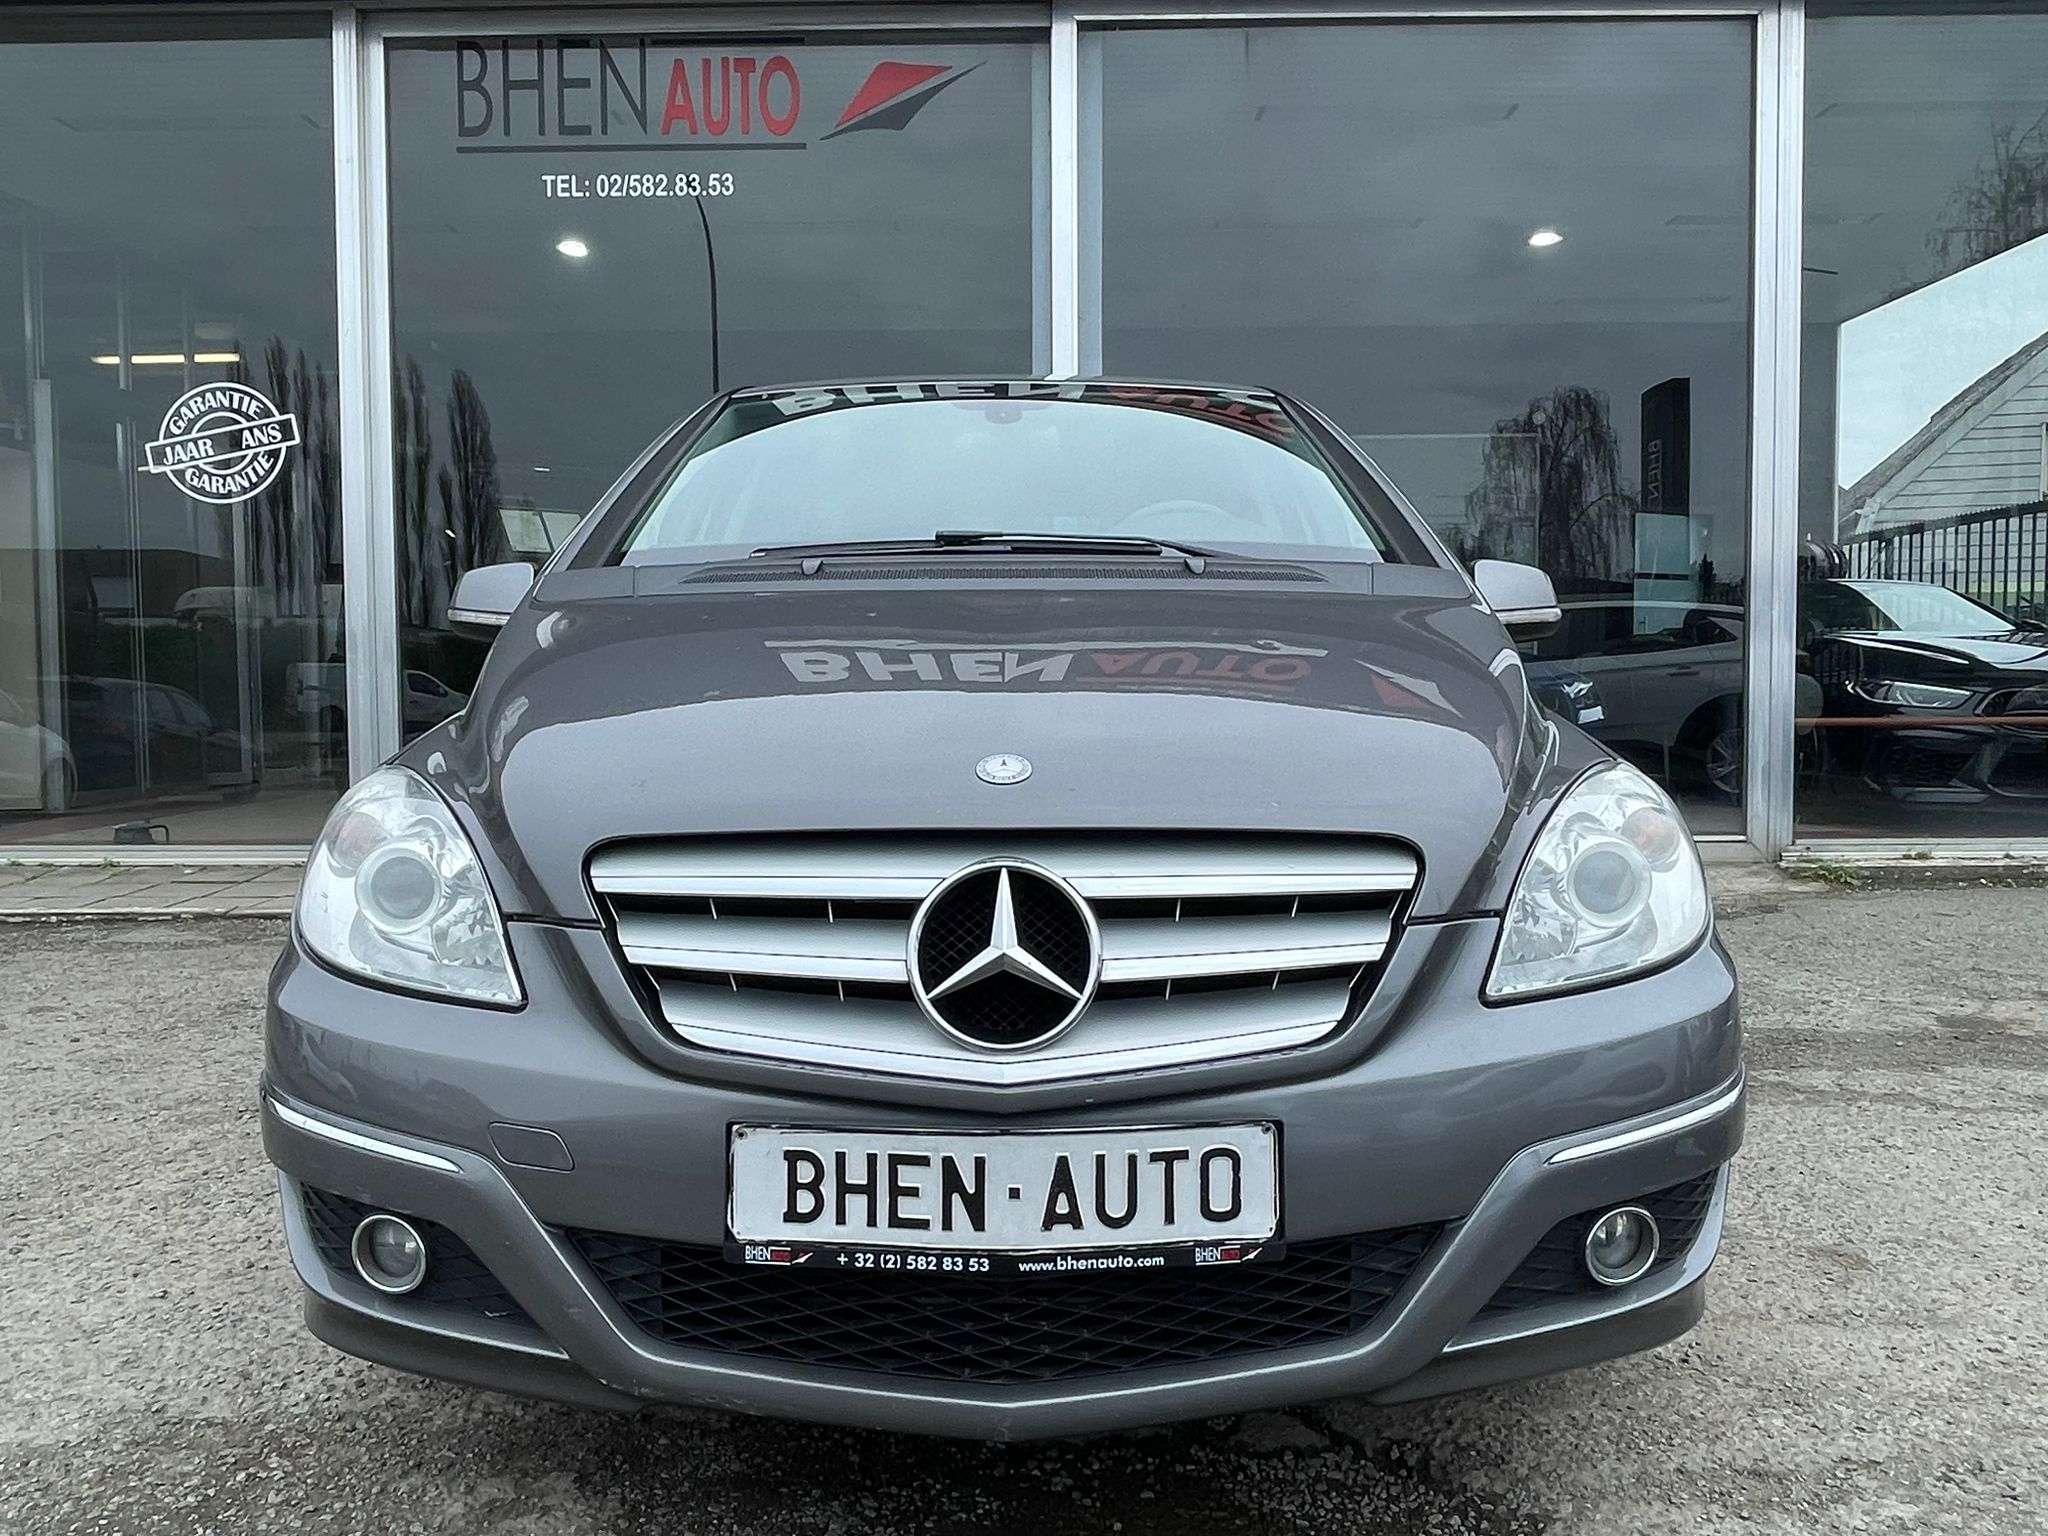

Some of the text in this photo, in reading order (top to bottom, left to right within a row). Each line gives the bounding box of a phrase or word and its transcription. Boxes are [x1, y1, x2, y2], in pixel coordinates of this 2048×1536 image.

[456, 37, 801, 138] BHEN AUTO
[541, 172, 735, 198] TEL: 02/582.83.53
[168, 390, 265, 436] GARANTIE
[162, 422, 283, 466] JAAR ANS
[184, 451, 275, 494] GARANTIE
[781, 1147, 988, 1232] BHEN
[1040, 1146, 1244, 1232] AUTO
[744, 1244, 771, 1261] BHEN
[854, 1252, 875, 1268] 32
[880, 1253, 901, 1269] (2)
[906, 1255, 937, 1271] 582
[942, 1256, 964, 1272] 83
[968, 1257, 990, 1272] 53
[1018, 1255, 1165, 1272] www.bhenauto.com
